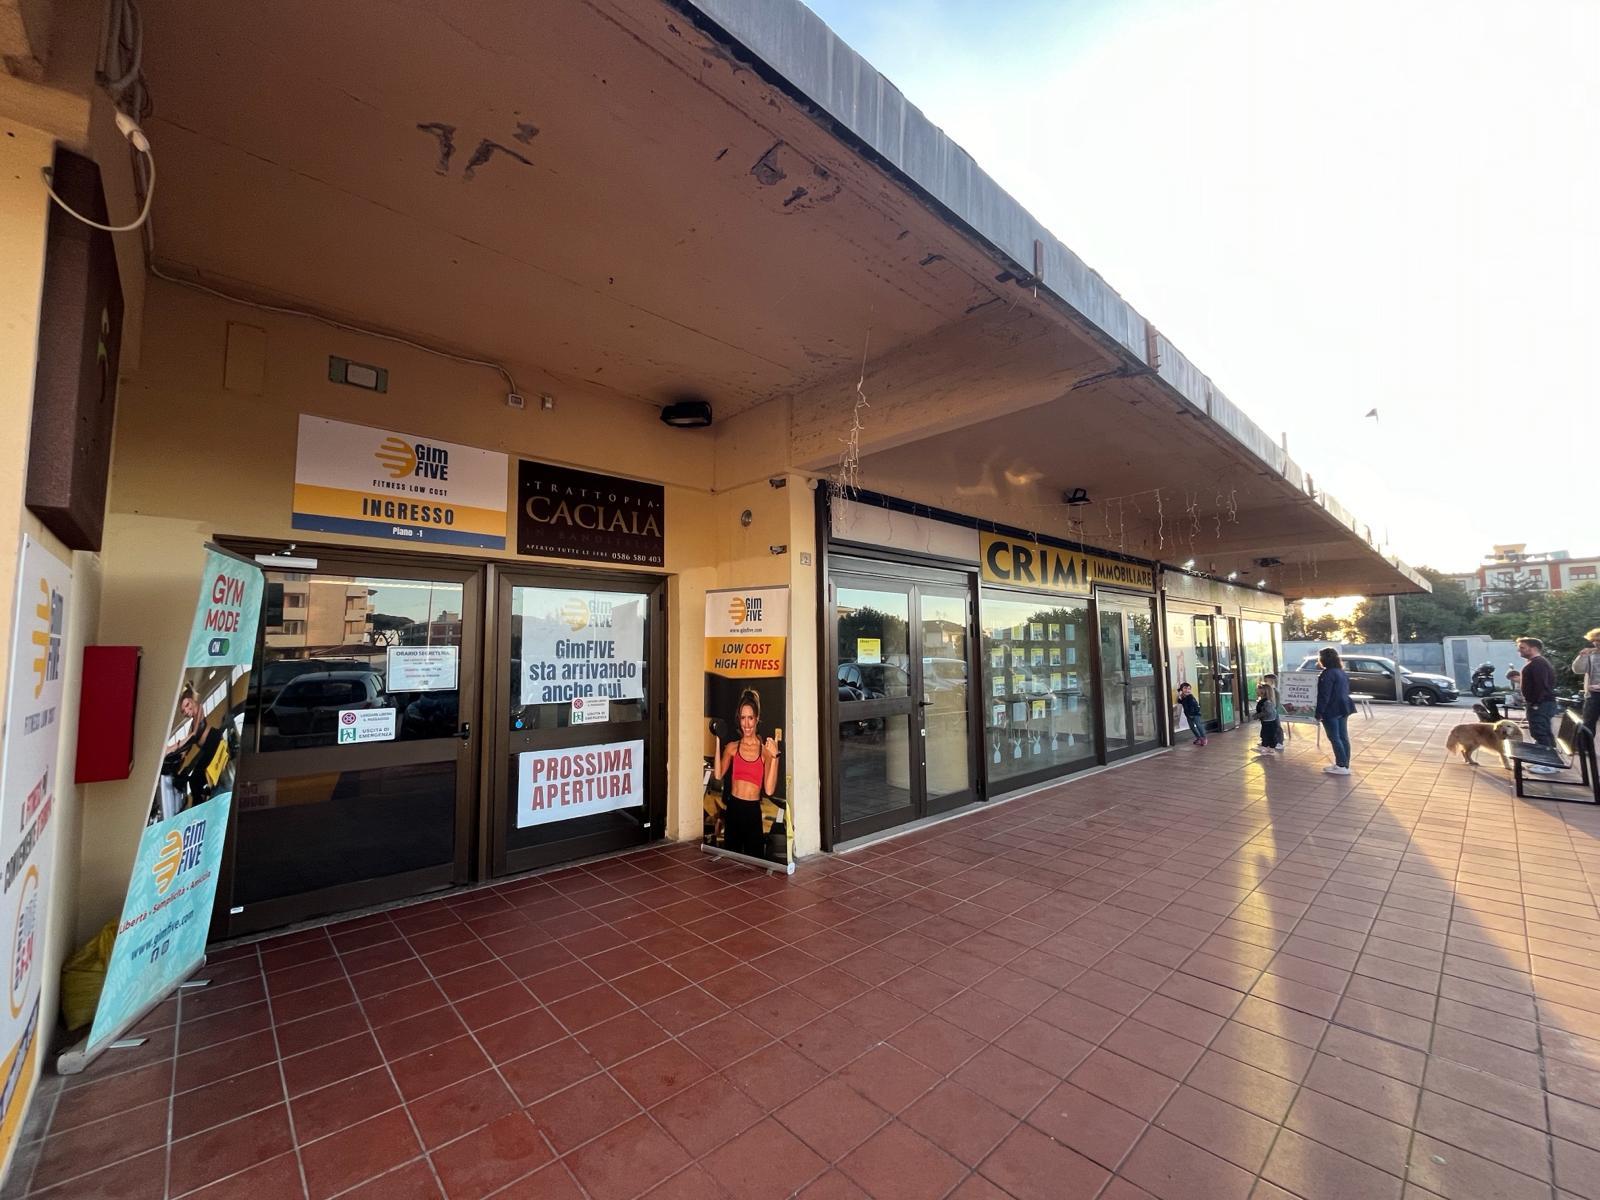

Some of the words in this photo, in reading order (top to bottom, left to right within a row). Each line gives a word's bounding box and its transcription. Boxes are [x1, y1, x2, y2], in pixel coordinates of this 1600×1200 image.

[415, 460, 449, 481] FIVE
[372, 479, 406, 490] FITNESS
[409, 484, 426, 493] LOW
[429, 487, 448, 497] COST
[362, 497, 454, 526] INGRESSO
[525, 496, 663, 538] CACIAIA
[392, 526, 413, 537] Piano
[611, 552, 631, 561] 0586
[632, 554, 647, 563] 580
[987, 541, 1088, 587] CRIMI
[1093, 560, 1152, 586] IMMOBILIARE
[212, 574, 245, 607] GYM
[204, 608, 241, 633] MODE
[745, 610, 762, 621] FIVE
[555, 639, 615, 659] GimFIVE
[722, 643, 744, 654] LOW
[745, 643, 771, 655] COST
[529, 661, 556, 681] sta
[561, 660, 637, 680] arrivando
[714, 658, 738, 669] HIGH
[739, 659, 780, 670] FITNESS
[542, 681, 593, 702] anche
[532, 748, 632, 783] PROSSIMA
[531, 773, 632, 811] APERTURA
[177, 843, 202, 876] FIVE
[131, 911, 194, 960] www.gimfive.com
